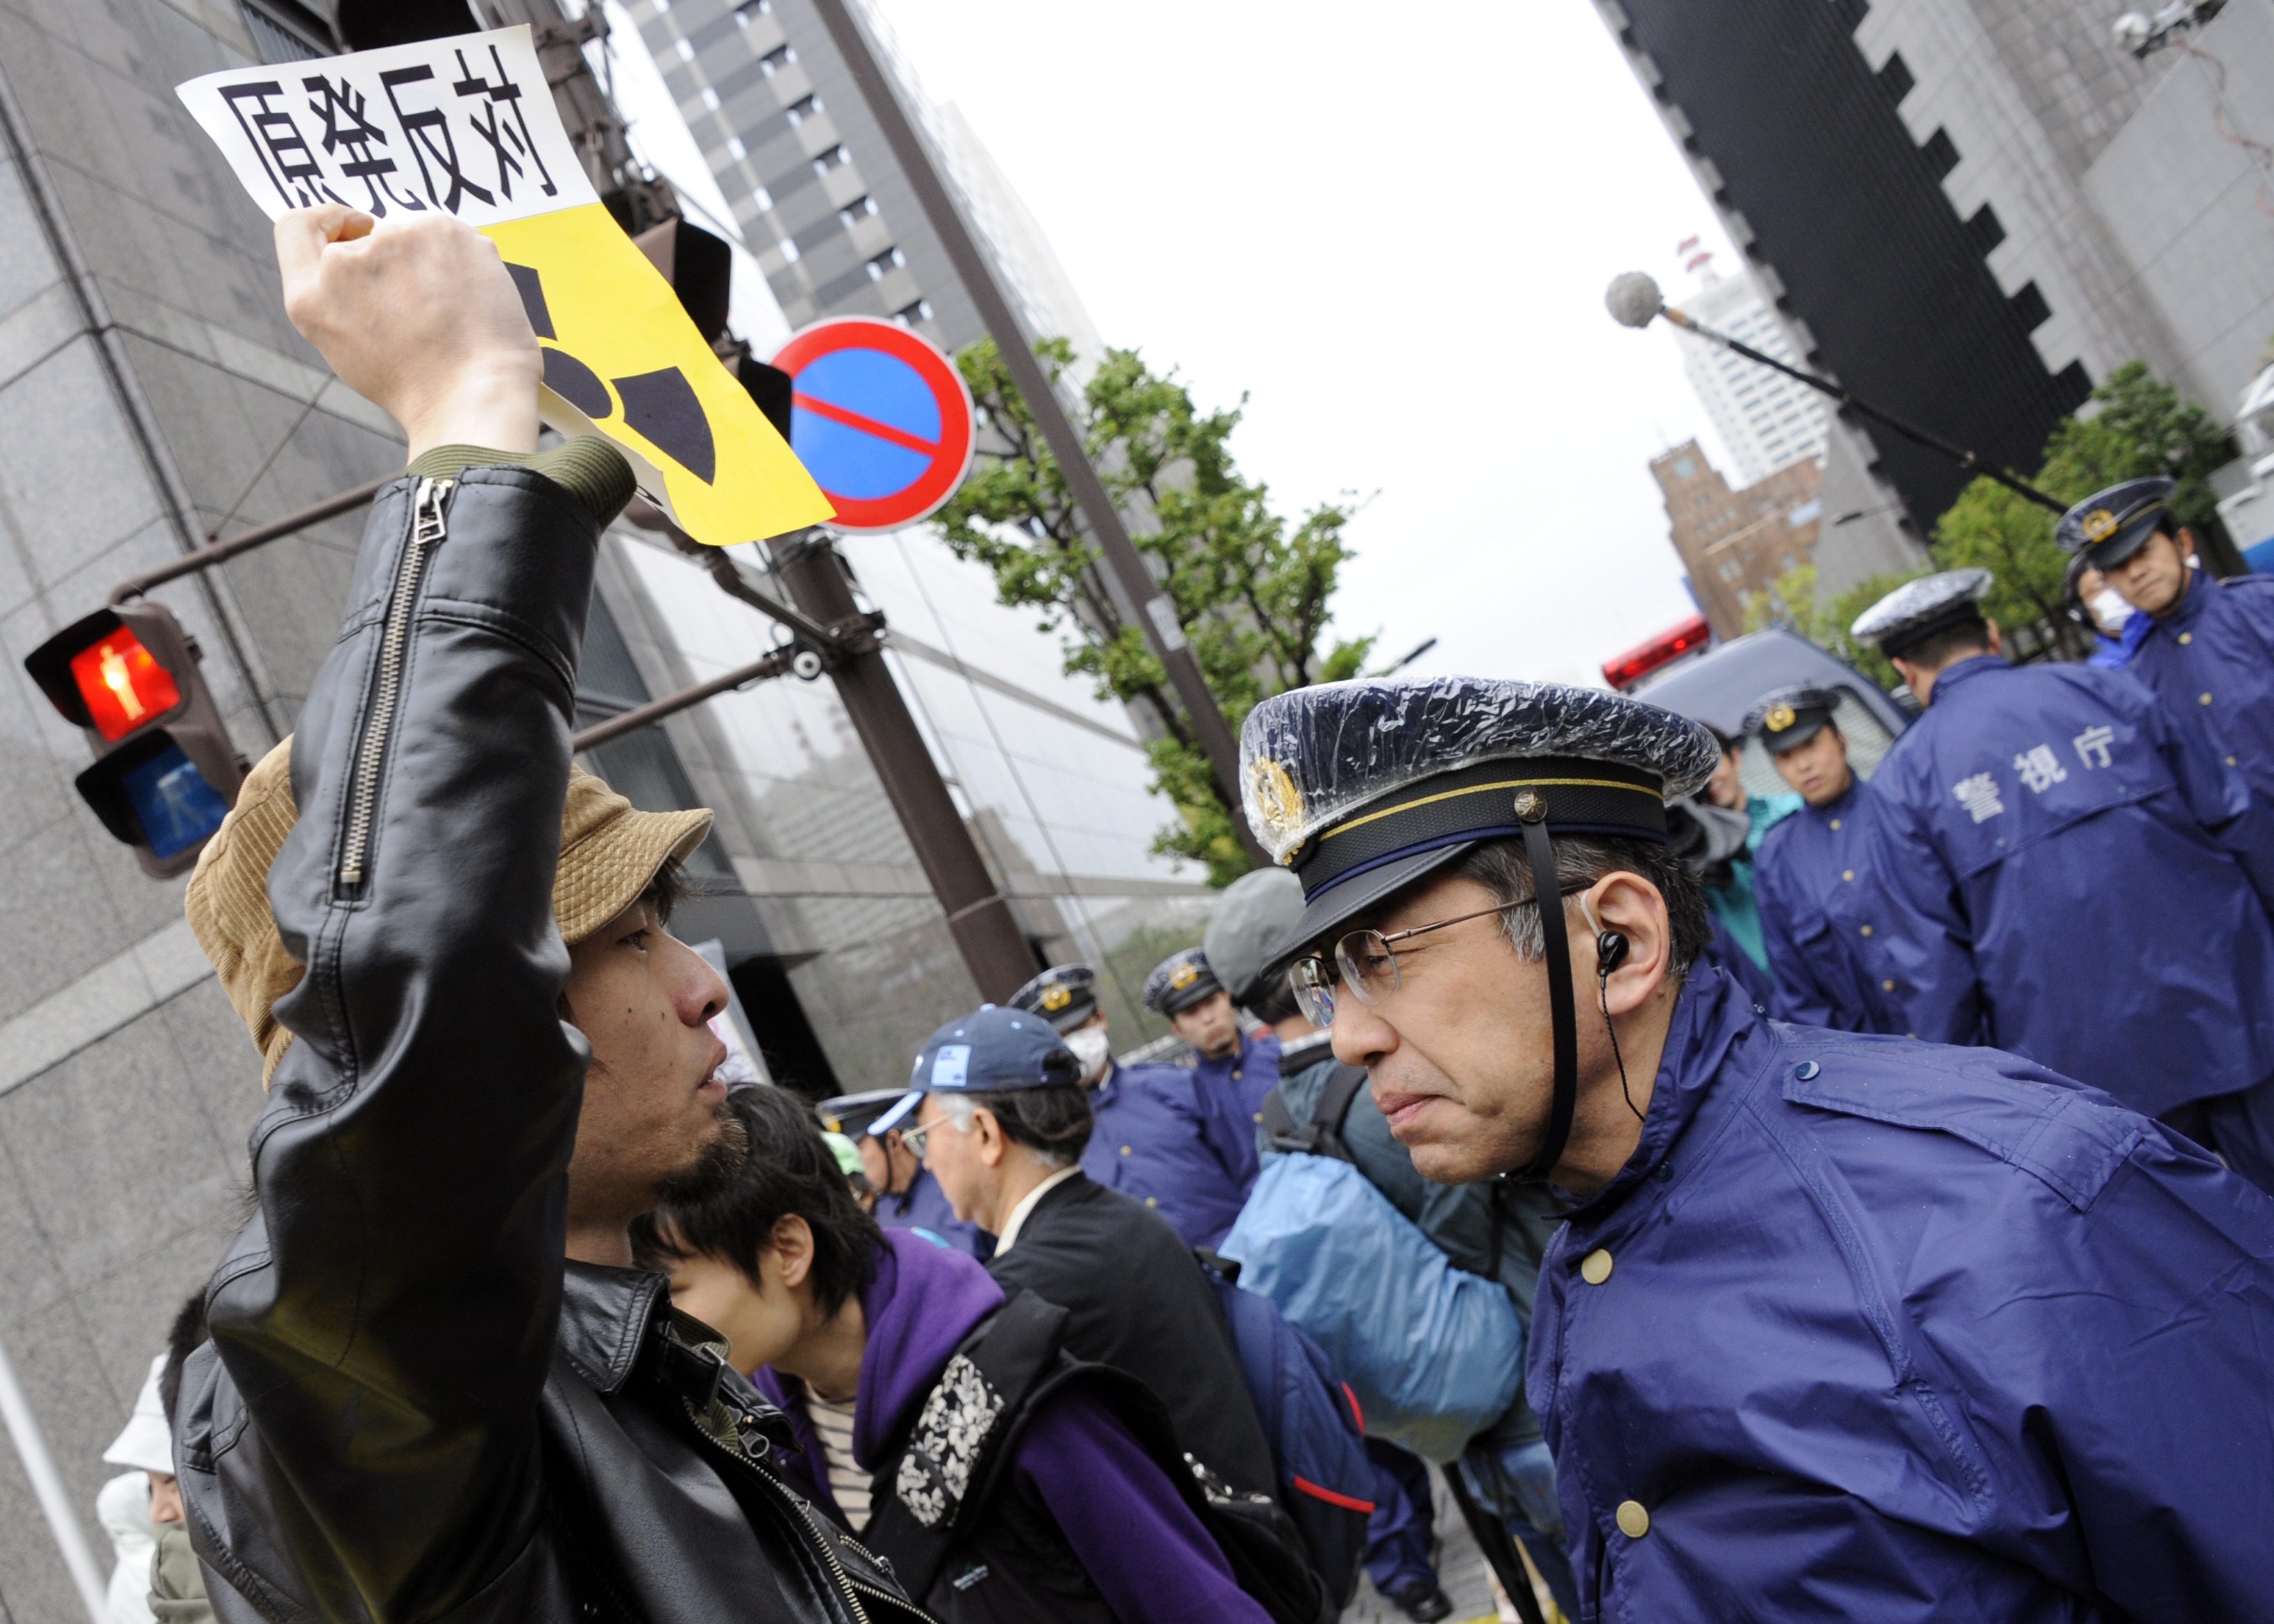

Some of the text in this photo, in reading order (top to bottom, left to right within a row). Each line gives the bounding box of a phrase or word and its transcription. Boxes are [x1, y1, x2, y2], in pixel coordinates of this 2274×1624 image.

[218, 44, 557, 216] 原発反対
[1952, 725, 2114, 824] 警視庁
